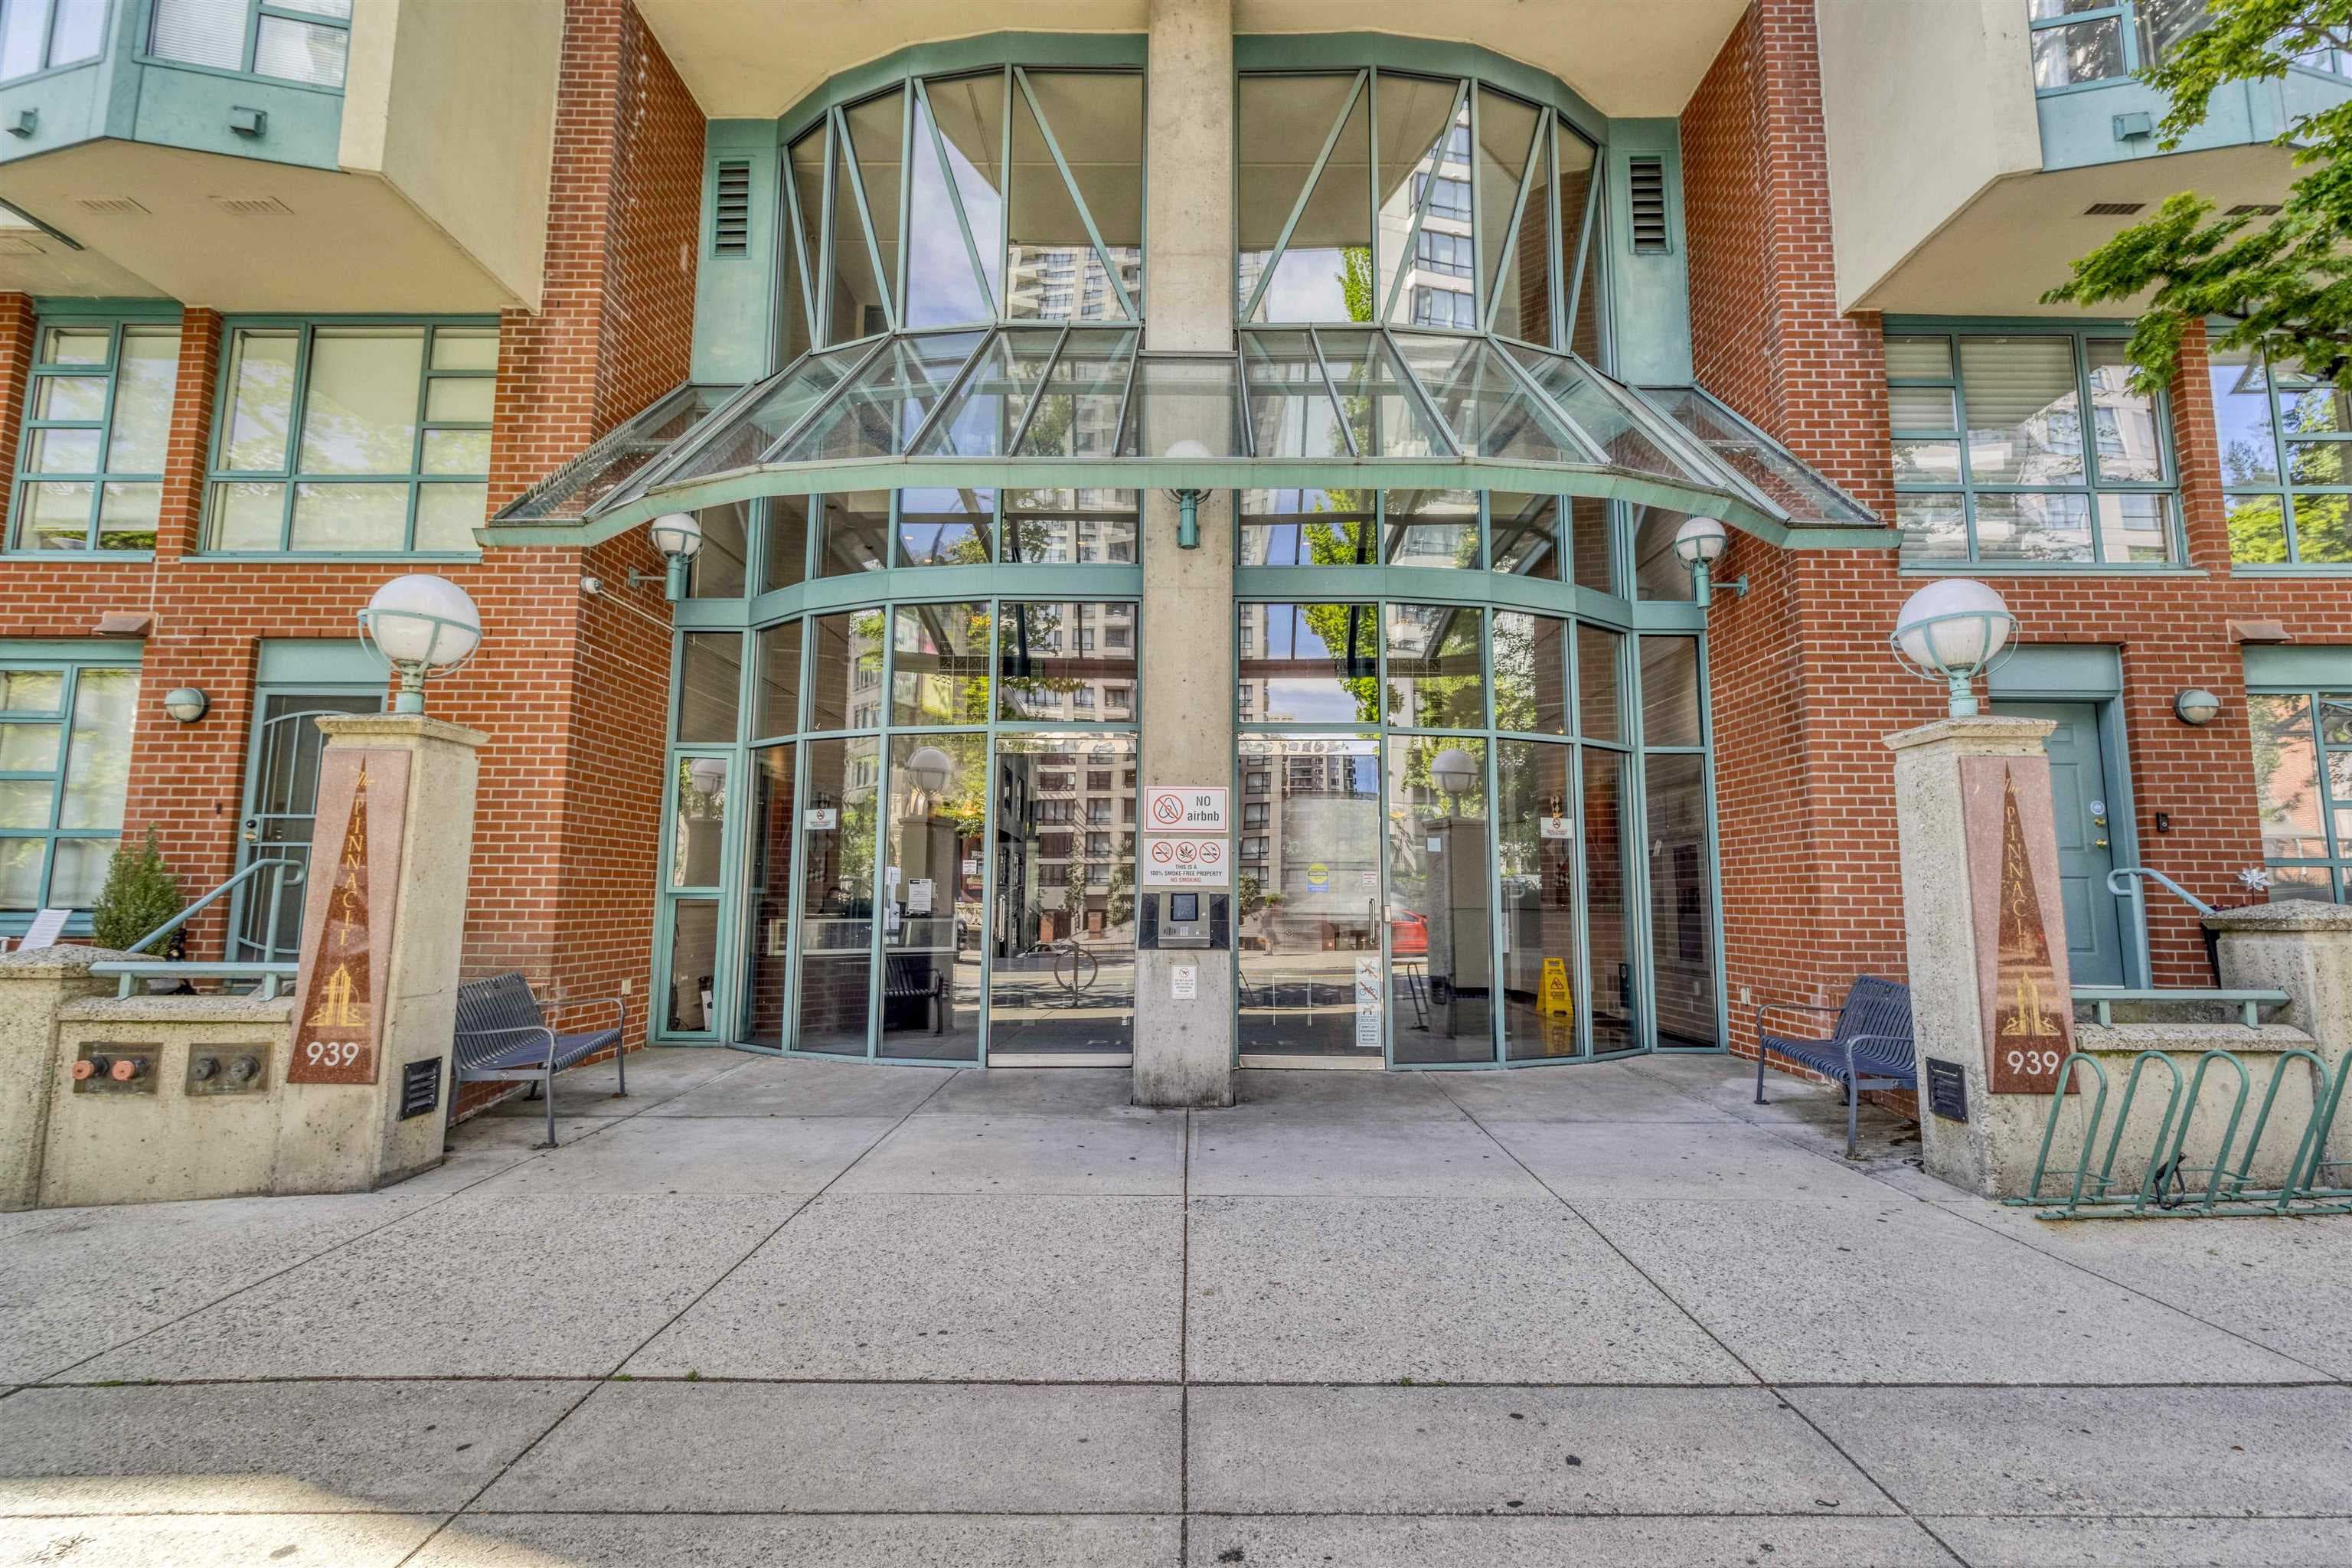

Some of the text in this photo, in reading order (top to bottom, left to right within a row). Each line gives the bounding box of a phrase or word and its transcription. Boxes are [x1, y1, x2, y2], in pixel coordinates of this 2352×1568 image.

[1196, 795, 1210, 806] NO
[1187, 810, 1220, 822] airbnb
[306, 1041, 359, 1067] 939
[2007, 1050, 2060, 1075] 939
